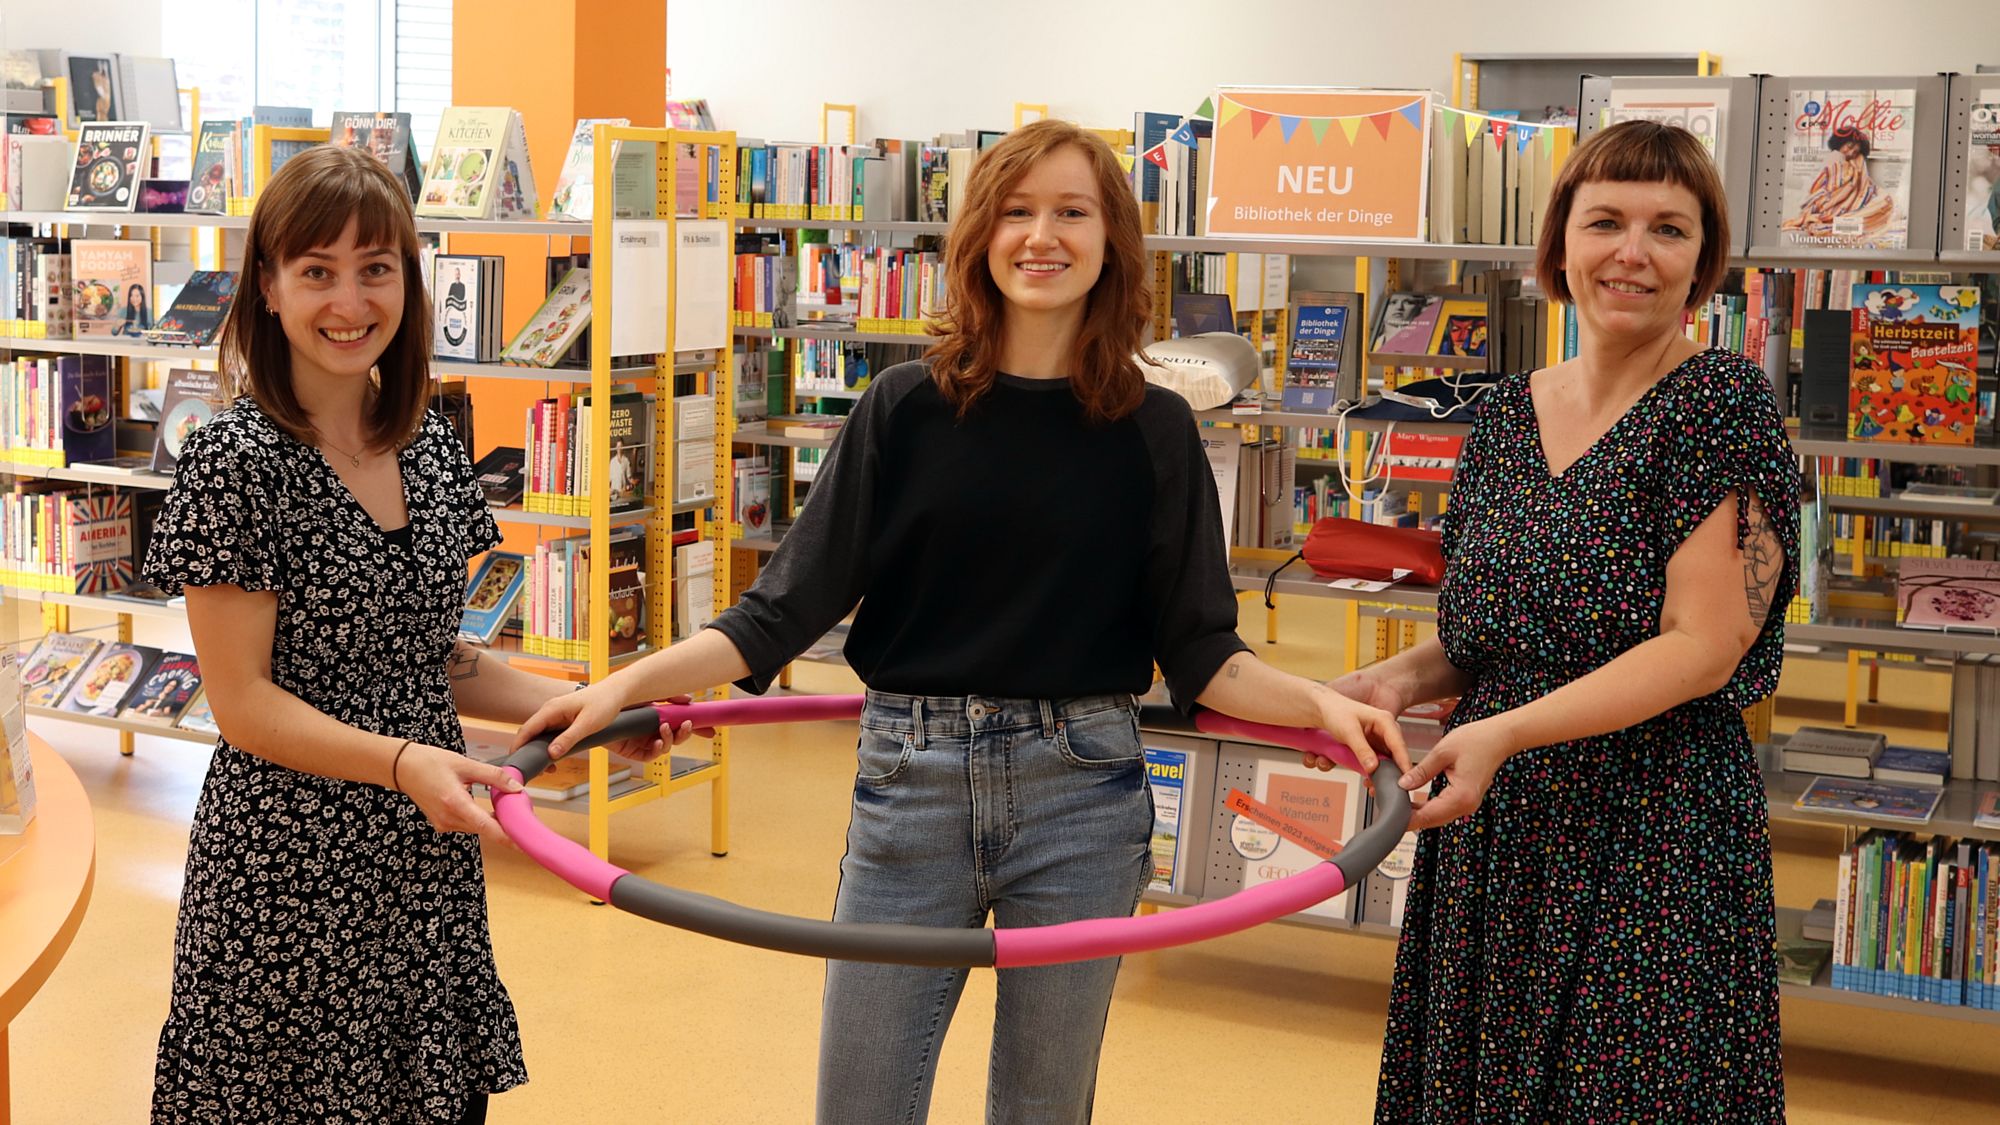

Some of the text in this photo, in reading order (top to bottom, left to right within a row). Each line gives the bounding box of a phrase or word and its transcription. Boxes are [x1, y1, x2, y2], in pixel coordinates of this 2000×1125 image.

[344, 114, 398, 129] GÖNN DIR!
[1795, 100, 1905, 137] Mollie
[85, 129, 140, 142] BRINNER
[448, 127, 492, 139] KITCHEN
[1179, 130, 1190, 141] U
[1496, 125, 1503, 136] E
[1520, 129, 1528, 141] U
[1152, 151, 1163, 162] E
[1277, 165, 1353, 194] NEU
[1234, 206, 1393, 227] Bibliothek der Dinge
[620, 235, 647, 245] Ernährung
[696, 234, 711, 243] Schön
[1789, 233, 1841, 244] Momente
[80, 261, 124, 271] FOODS
[1301, 319, 1339, 327] Bibliothek
[1859, 309, 1867, 331] TOPP
[1299, 327, 1336, 337] der Dinge
[1874, 326, 1955, 340] Herbstzeit
[1911, 342, 1974, 359] Bastelzeit
[1152, 356, 1210, 366] KNUUT
[612, 409, 630, 419] ZERO
[610, 418, 632, 427] WASTE
[1396, 432, 1449, 443] Mary Wigman
[149, 668, 199, 690] COOKING
[1145, 762, 1185, 780] ravel
[1281, 791, 1330, 808] Reisen &
[1236, 798, 1281, 827] Erscheinen
[1282, 823, 1303, 840] 2023
[1280, 807, 1329, 823] Wandern
[1258, 865, 1290, 879] GEO
[1988, 879, 1997, 914] YOURSELF
[1945, 899, 1956, 948] PAPER MAGIC
